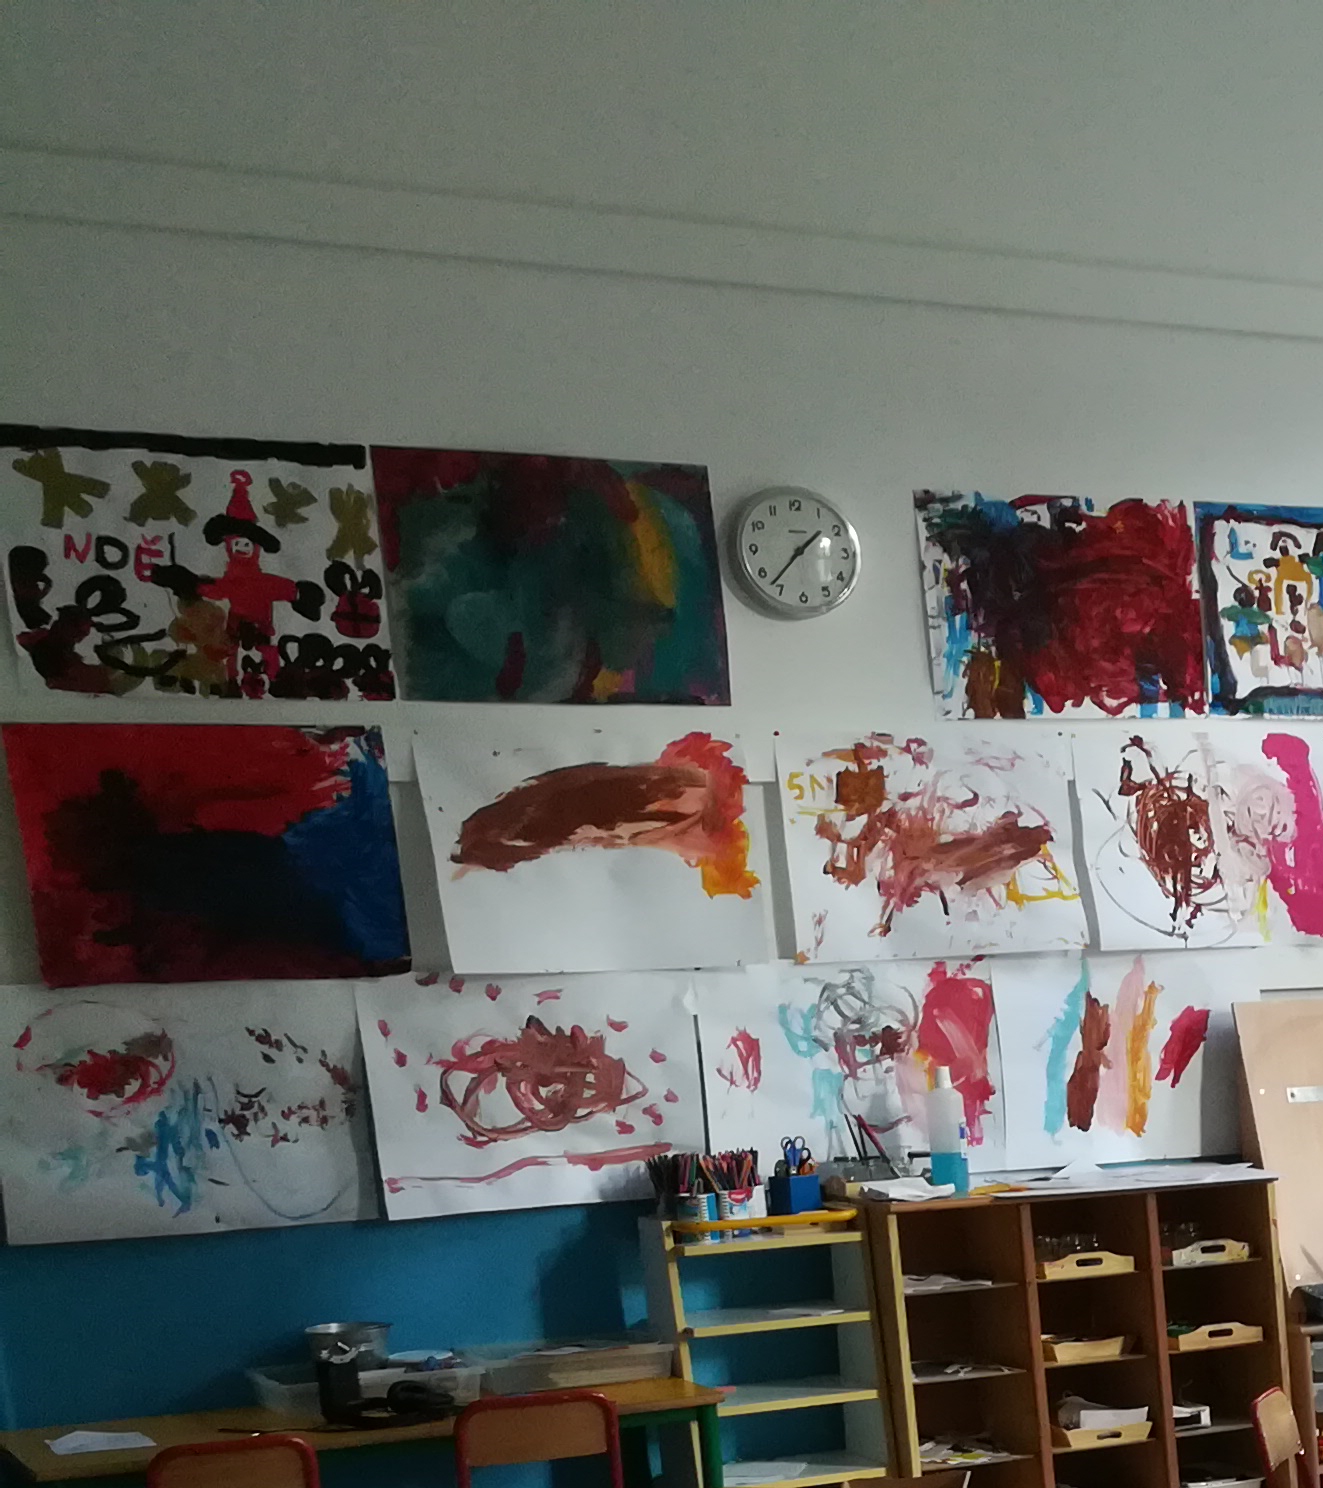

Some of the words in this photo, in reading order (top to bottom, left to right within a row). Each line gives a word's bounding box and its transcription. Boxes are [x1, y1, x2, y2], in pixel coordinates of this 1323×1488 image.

[768, 505, 777, 517] 11
[788, 499, 802, 512] 12
[751, 520, 765, 532] 10
[831, 524, 842, 537] 2
[748, 543, 759, 556] 9
[840, 547, 850, 560] 3
[757, 566, 768, 579] 8
[836, 570, 845, 582] 4
[775, 583, 785, 597] 7
[821, 585, 831, 598] 5
[798, 591, 809, 604] 6
